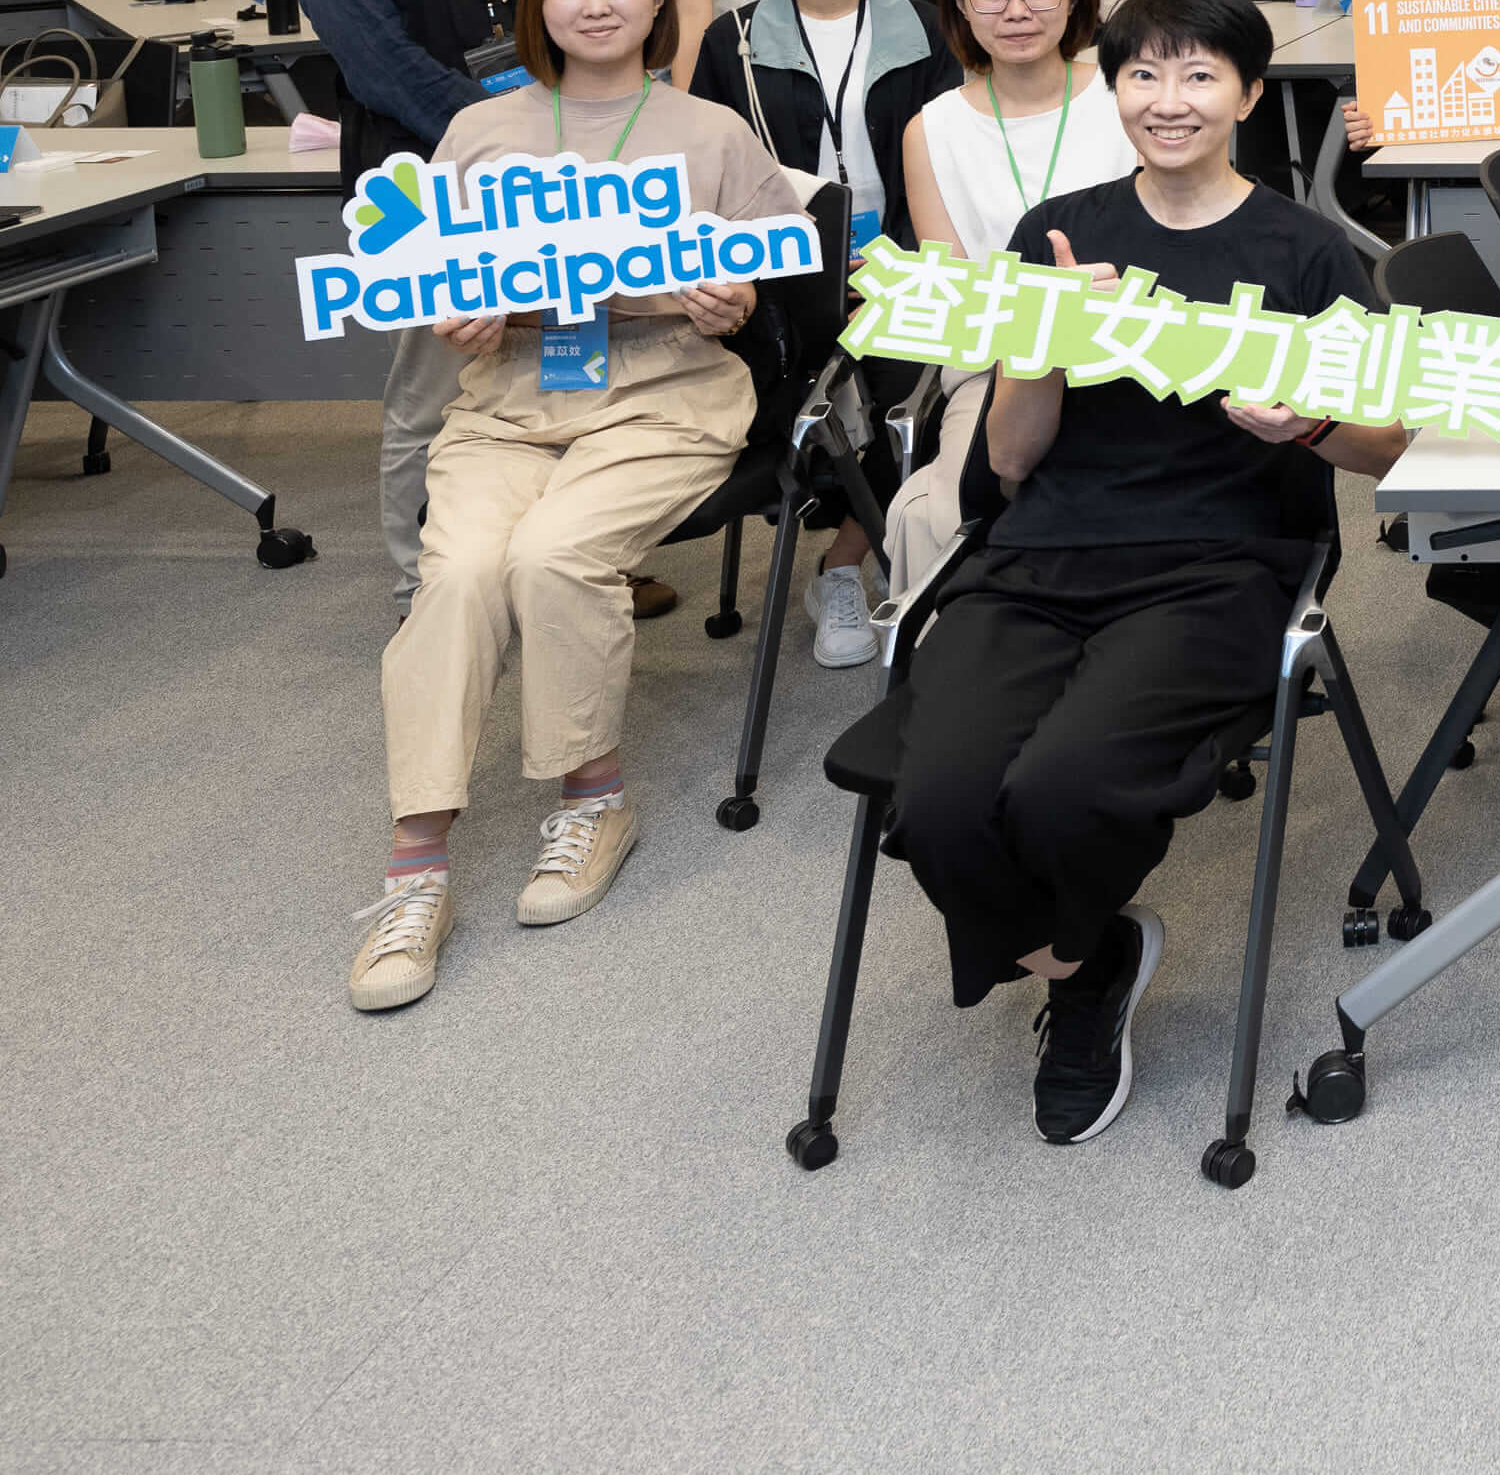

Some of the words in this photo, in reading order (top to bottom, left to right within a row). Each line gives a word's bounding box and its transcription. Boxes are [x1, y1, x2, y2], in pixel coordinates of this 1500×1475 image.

[1364, 2, 1389, 35] 11
[1398, 19, 1422, 33] AND
[1424, 15, 1500, 33] COMMUNITIES
[433, 164, 679, 229] Lifting
[311, 223, 812, 331] Participation
